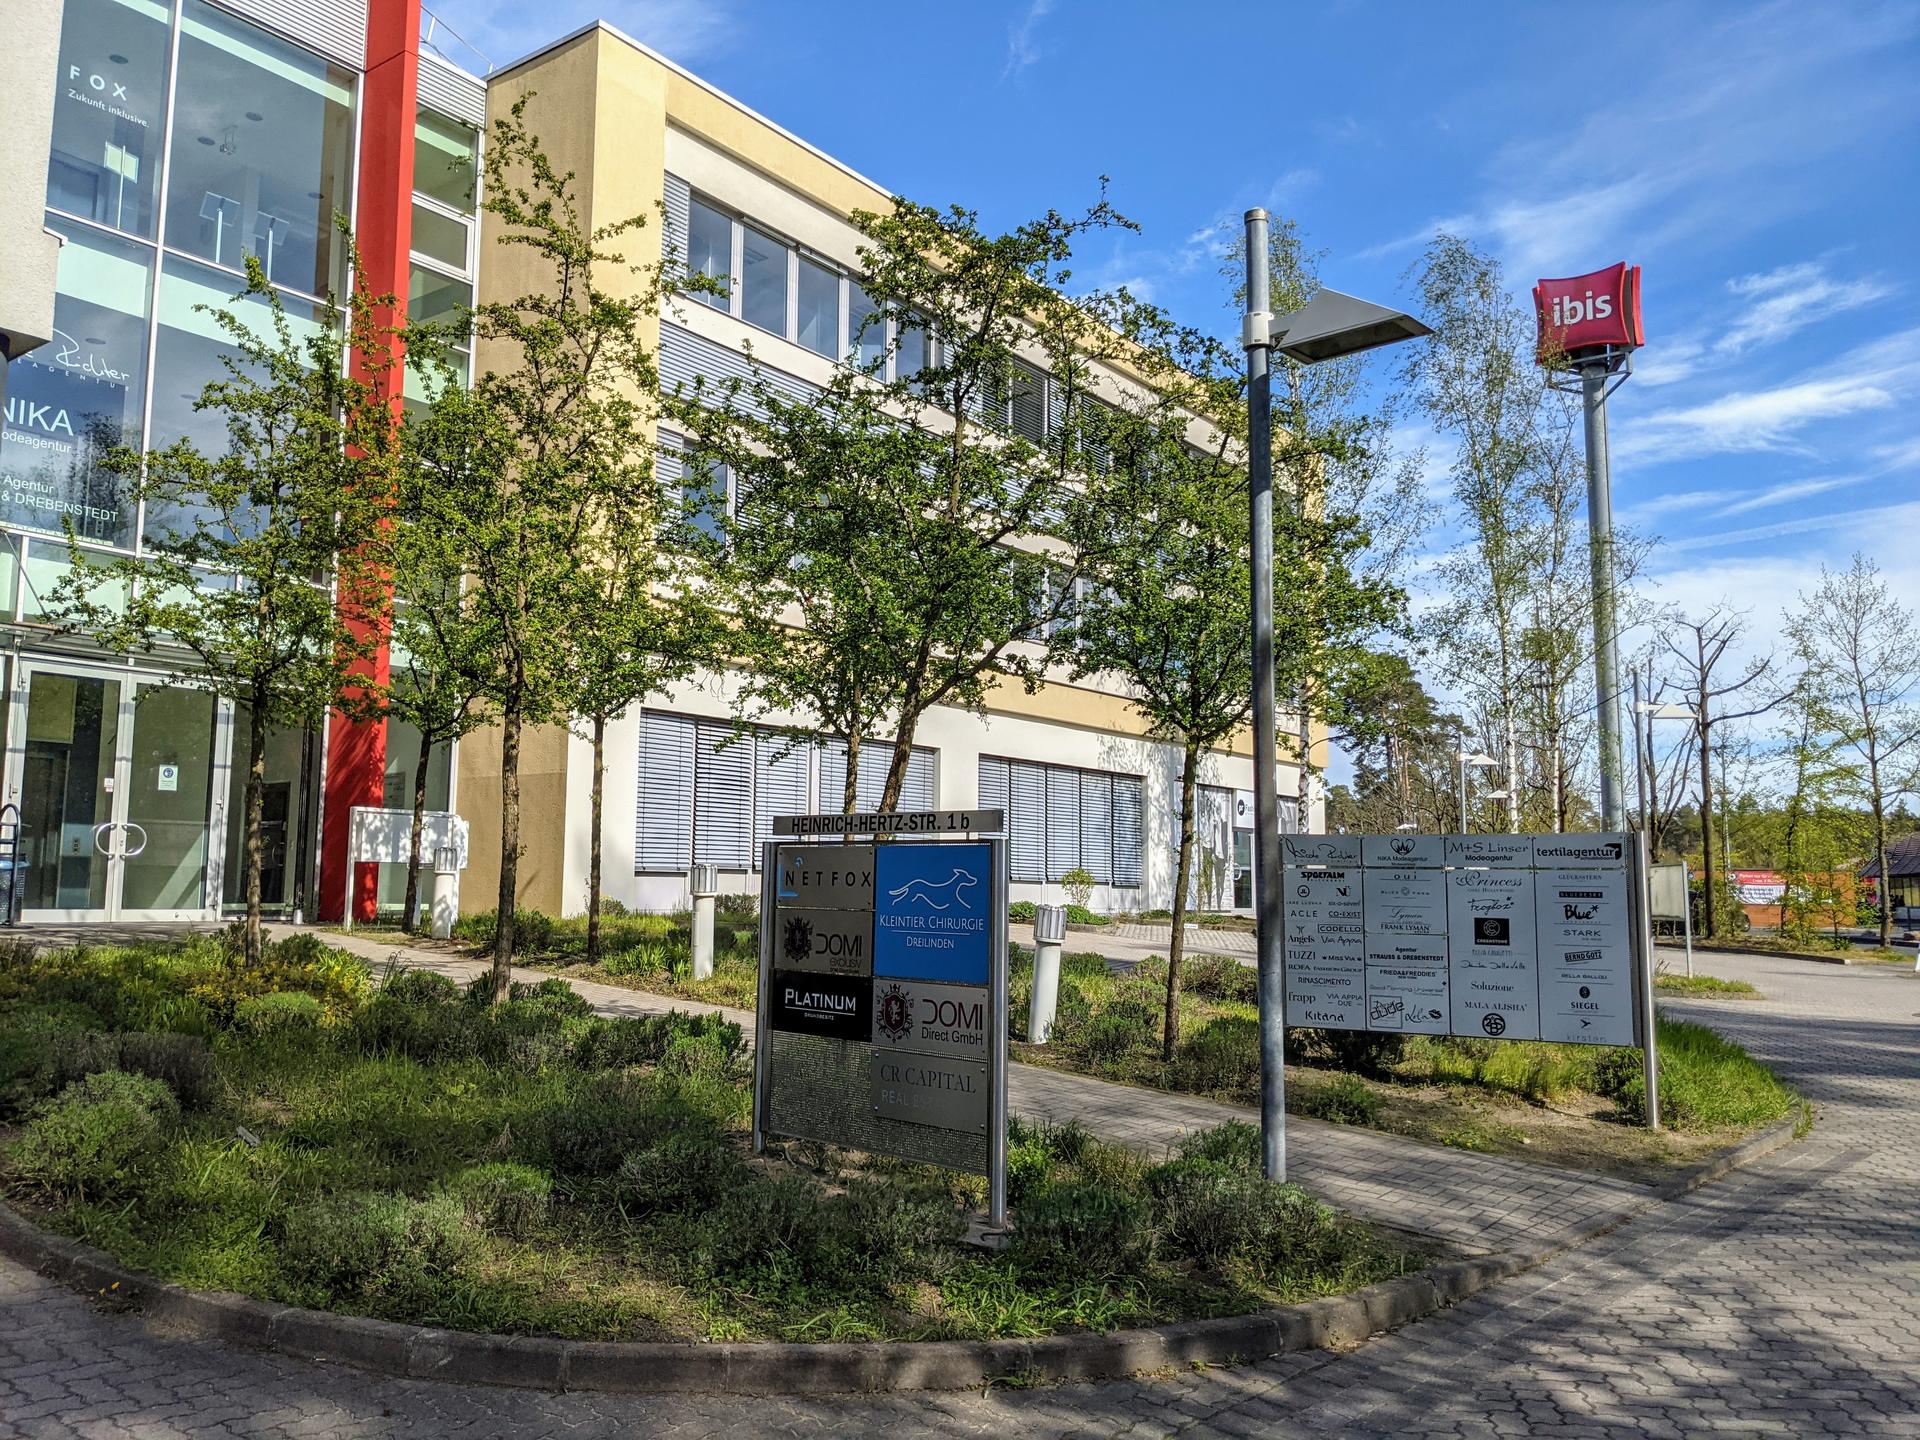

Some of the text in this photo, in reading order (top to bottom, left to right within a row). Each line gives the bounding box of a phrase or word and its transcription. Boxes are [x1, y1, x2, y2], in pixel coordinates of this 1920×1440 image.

[69, 64, 127, 102] FOX
[68, 88, 150, 128] Zukunft inklusive.
[1553, 291, 1612, 327] ibis
[2, 475, 54, 494] Agentur
[1, 490, 119, 522] & DREBENSTEDT
[792, 813, 970, 833] HEINRICH-HERTZ-STR. 1 b
[1488, 842, 1529, 853] Linser
[1537, 847, 1615, 858] textilagentur
[785, 871, 872, 887] NETFOX
[1456, 871, 1522, 886] Princess
[1291, 910, 1318, 918] ACLE
[879, 914, 984, 931] KLEINTIER CHIRURGIE
[1288, 935, 1316, 945] Angels
[1563, 929, 1602, 937] STARK
[816, 933, 862, 957] DOMI
[906, 936, 955, 949] DREILINDEN
[1288, 950, 1316, 960] TUZZI
[1298, 977, 1351, 986] RINASCIMENTO
[1471, 981, 1515, 992] Soluzione
[785, 988, 856, 1012] PLATINUM
[1288, 992, 1316, 1004] Frapp
[1570, 1002, 1599, 1010] SIEGEL
[922, 998, 983, 1031] DOMI
[921, 1027, 983, 1046] Direct GmbH
[880, 1064, 977, 1093] CR CAPITAL
